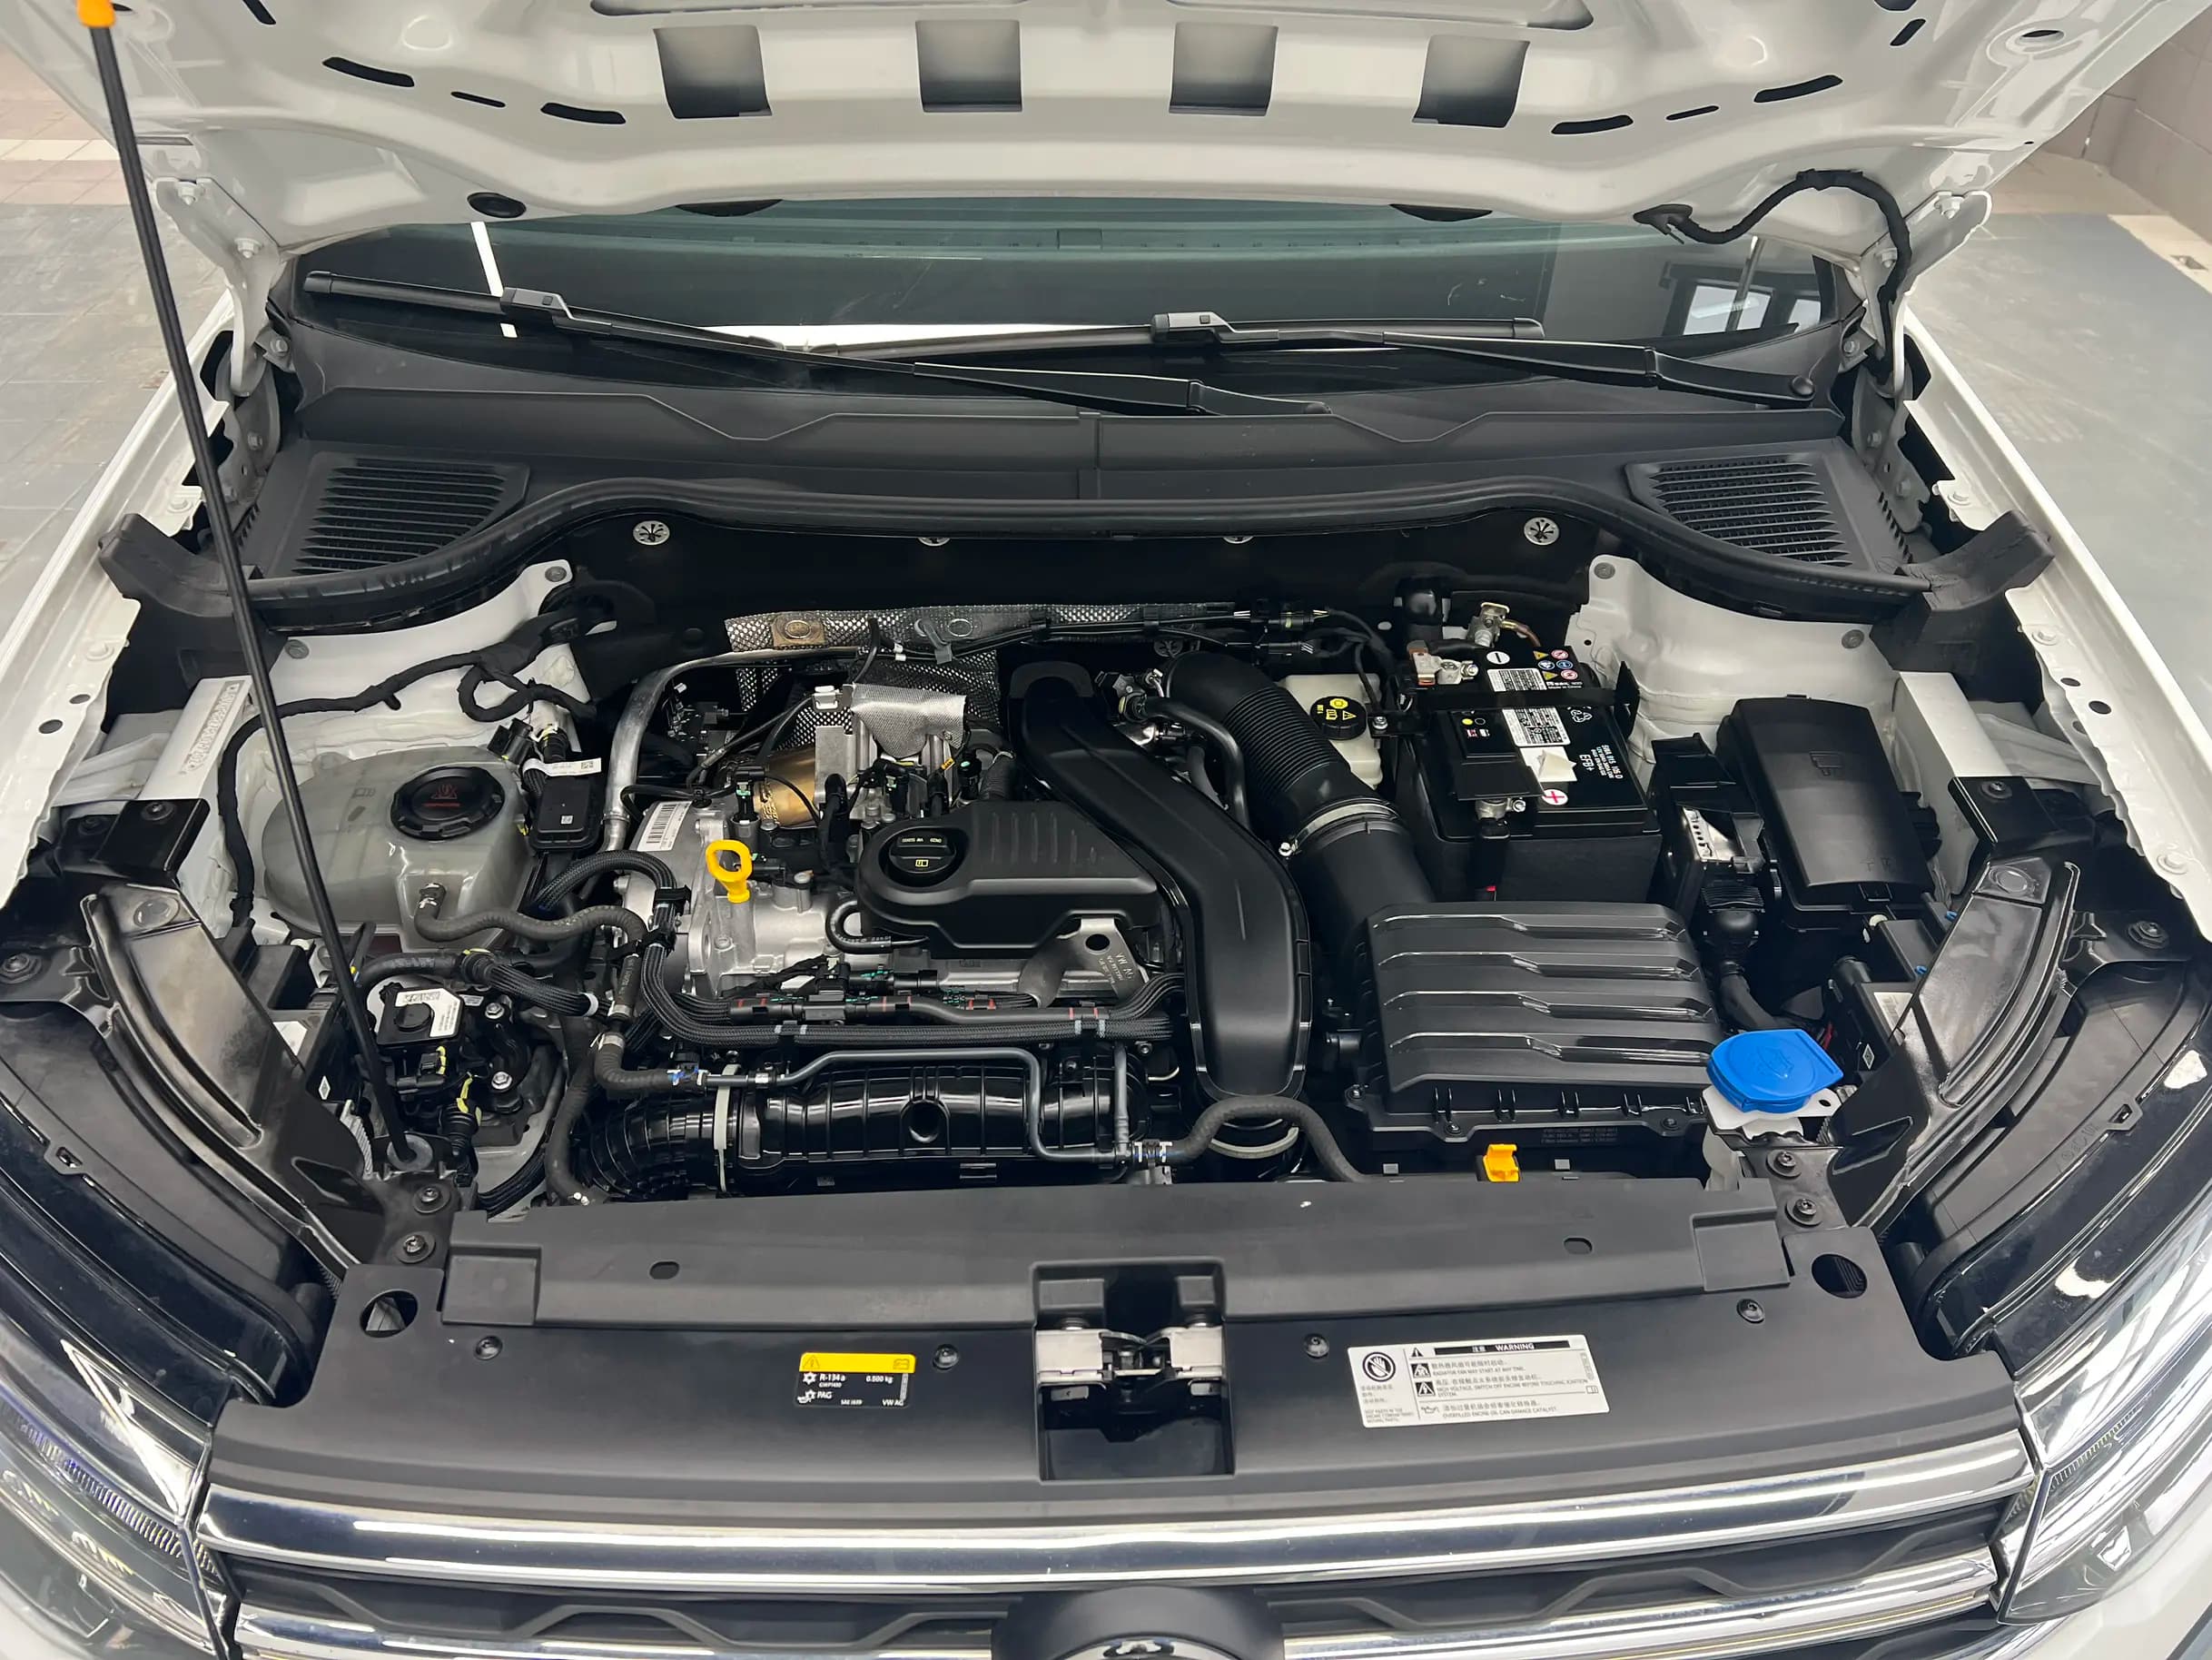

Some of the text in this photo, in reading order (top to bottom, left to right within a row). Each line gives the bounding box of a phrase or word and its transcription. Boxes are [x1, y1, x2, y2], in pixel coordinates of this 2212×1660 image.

[1579, 754, 1595, 772] EFB+
[1495, 1342, 1536, 1352] WARNING
[817, 1390, 833, 1399] PAG
[882, 1398, 894, 1407] VW
